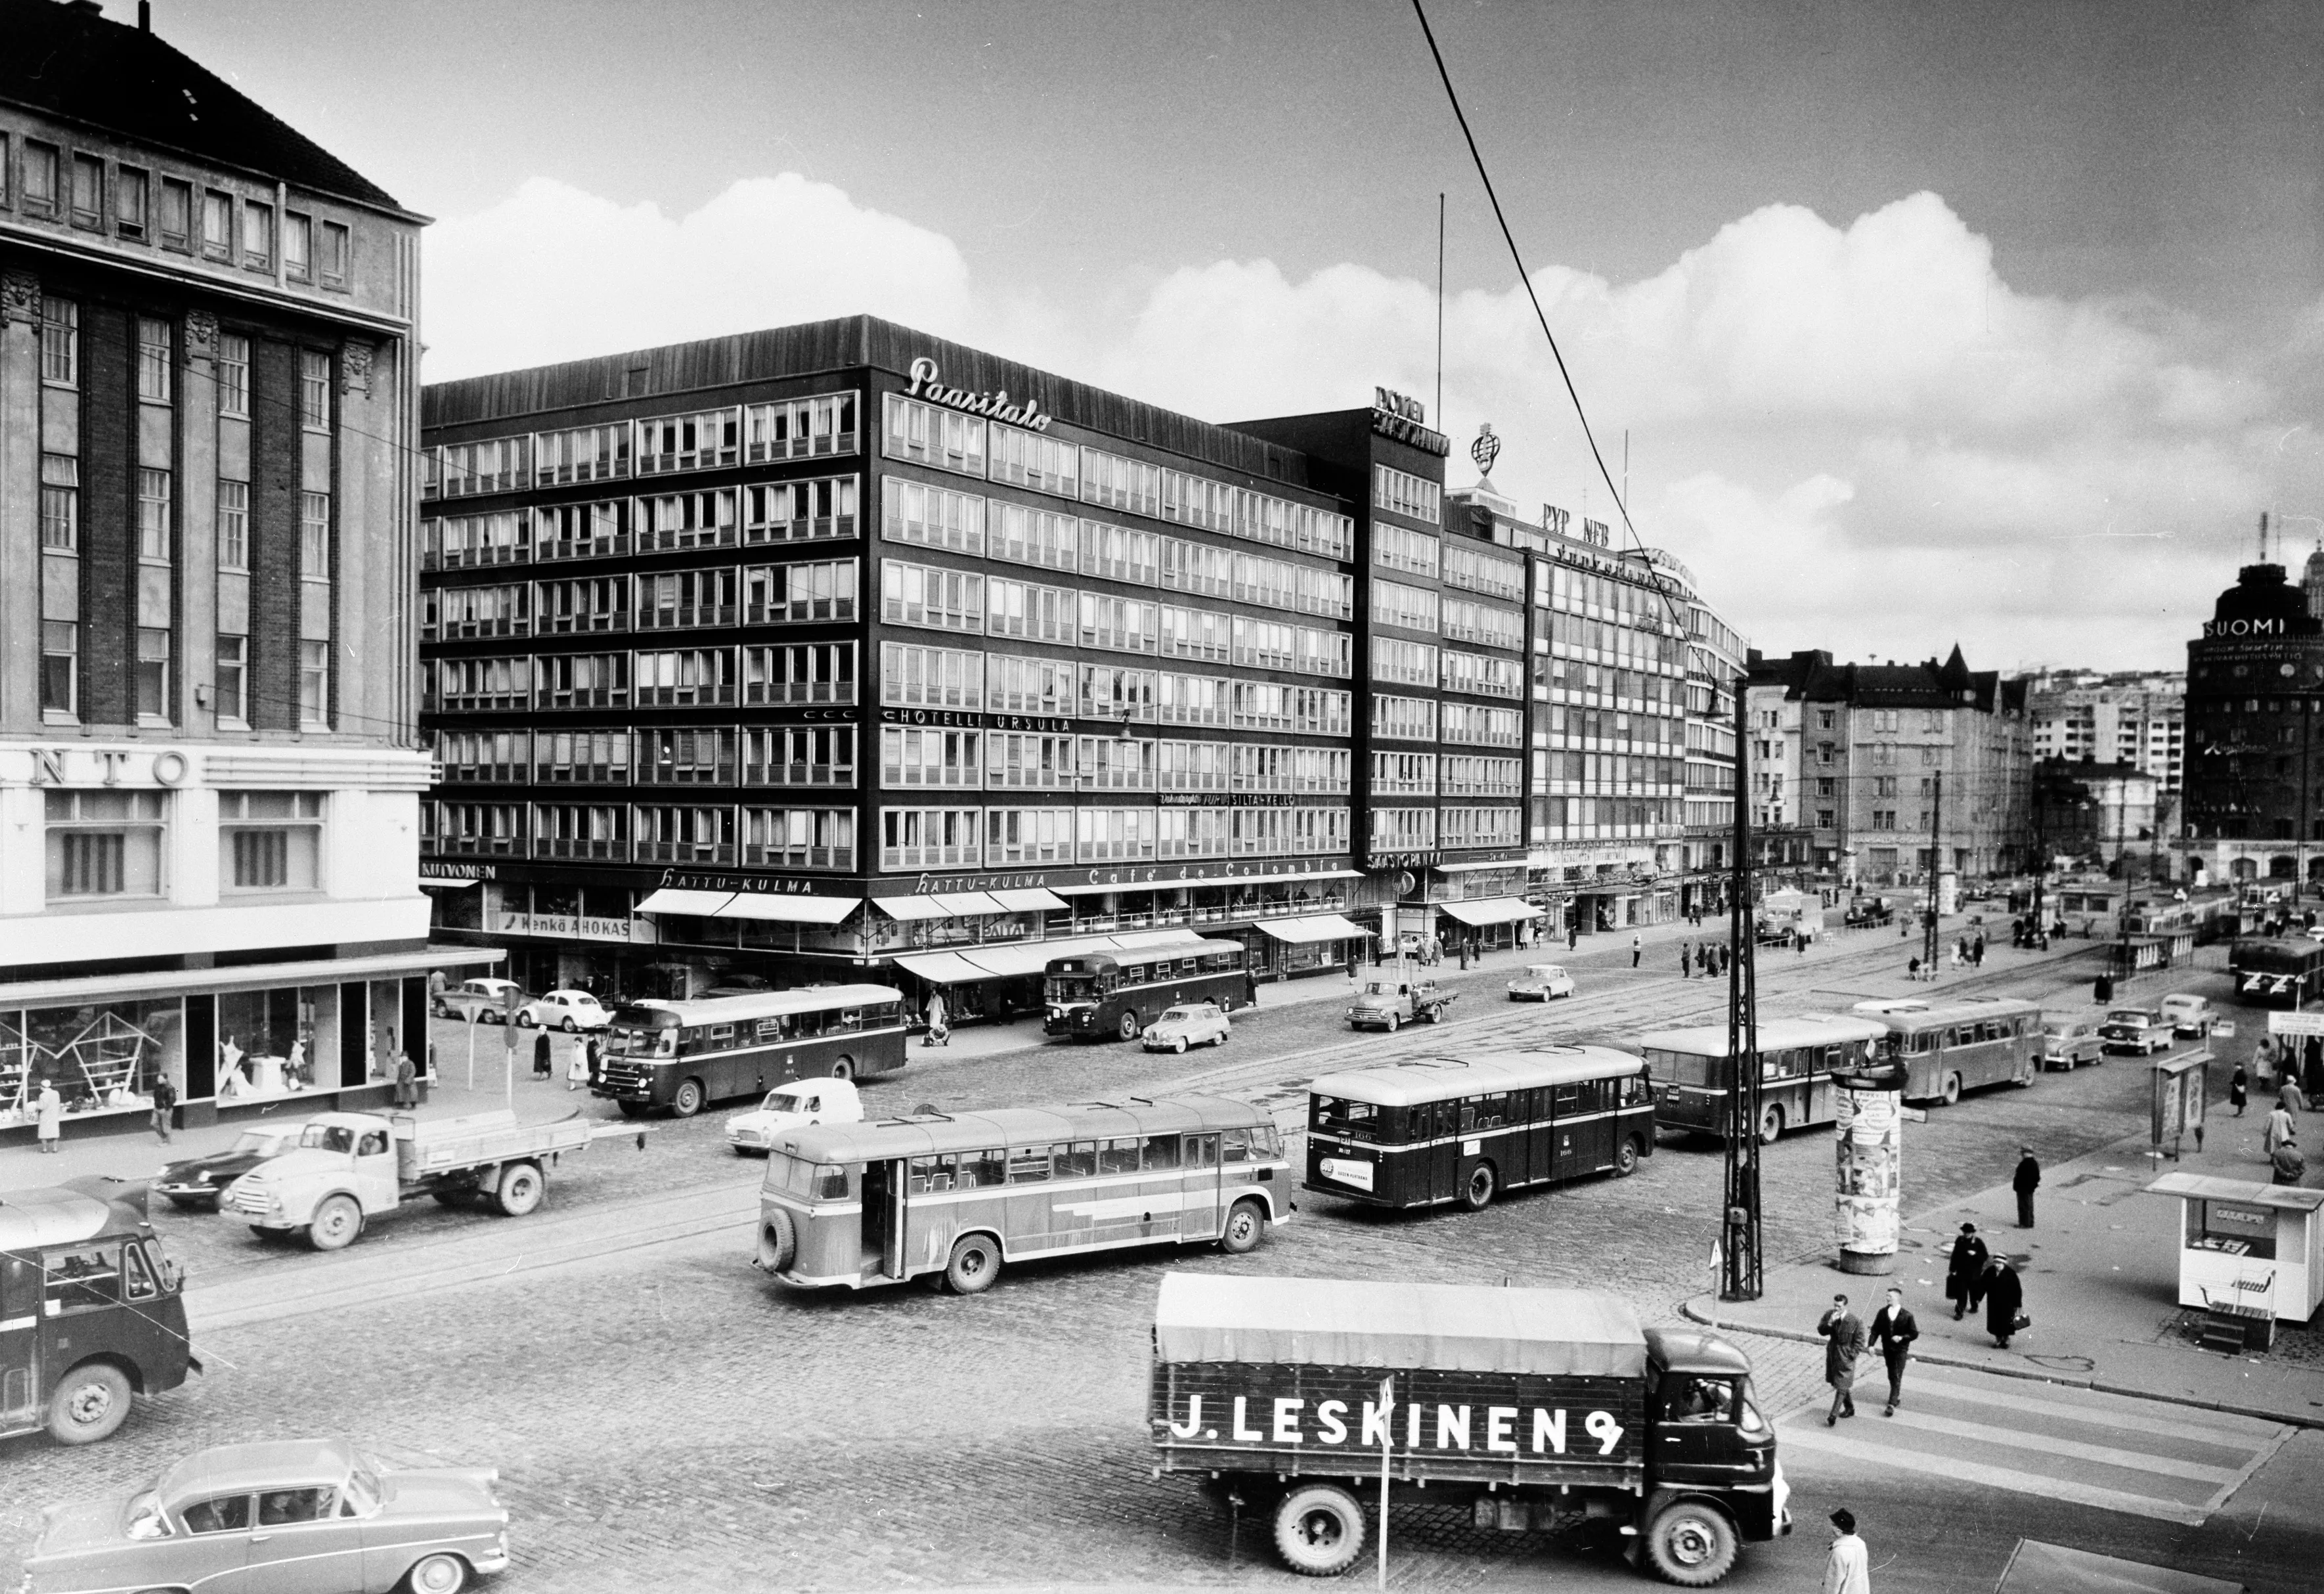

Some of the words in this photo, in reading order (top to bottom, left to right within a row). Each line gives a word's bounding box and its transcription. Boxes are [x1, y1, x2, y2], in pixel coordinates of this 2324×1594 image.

[904, 357, 1051, 432] Paasitalo
[1543, 503, 1569, 534] PYP
[2206, 618, 2284, 636] SUOMI
[900, 710, 982, 727] HOTELLI
[998, 715, 1070, 732] URSULA
[0, 747, 189, 787] NTO
[1233, 795, 1294, 806] SILTA-KELLO
[1226, 860, 1338, 877] Colombia
[571, 917, 630, 937] AHOKAS
[1355, 1132, 1372, 1141] 166
[1321, 1162, 1334, 1172] GULF
[1585, 1411, 1624, 1455] 9
